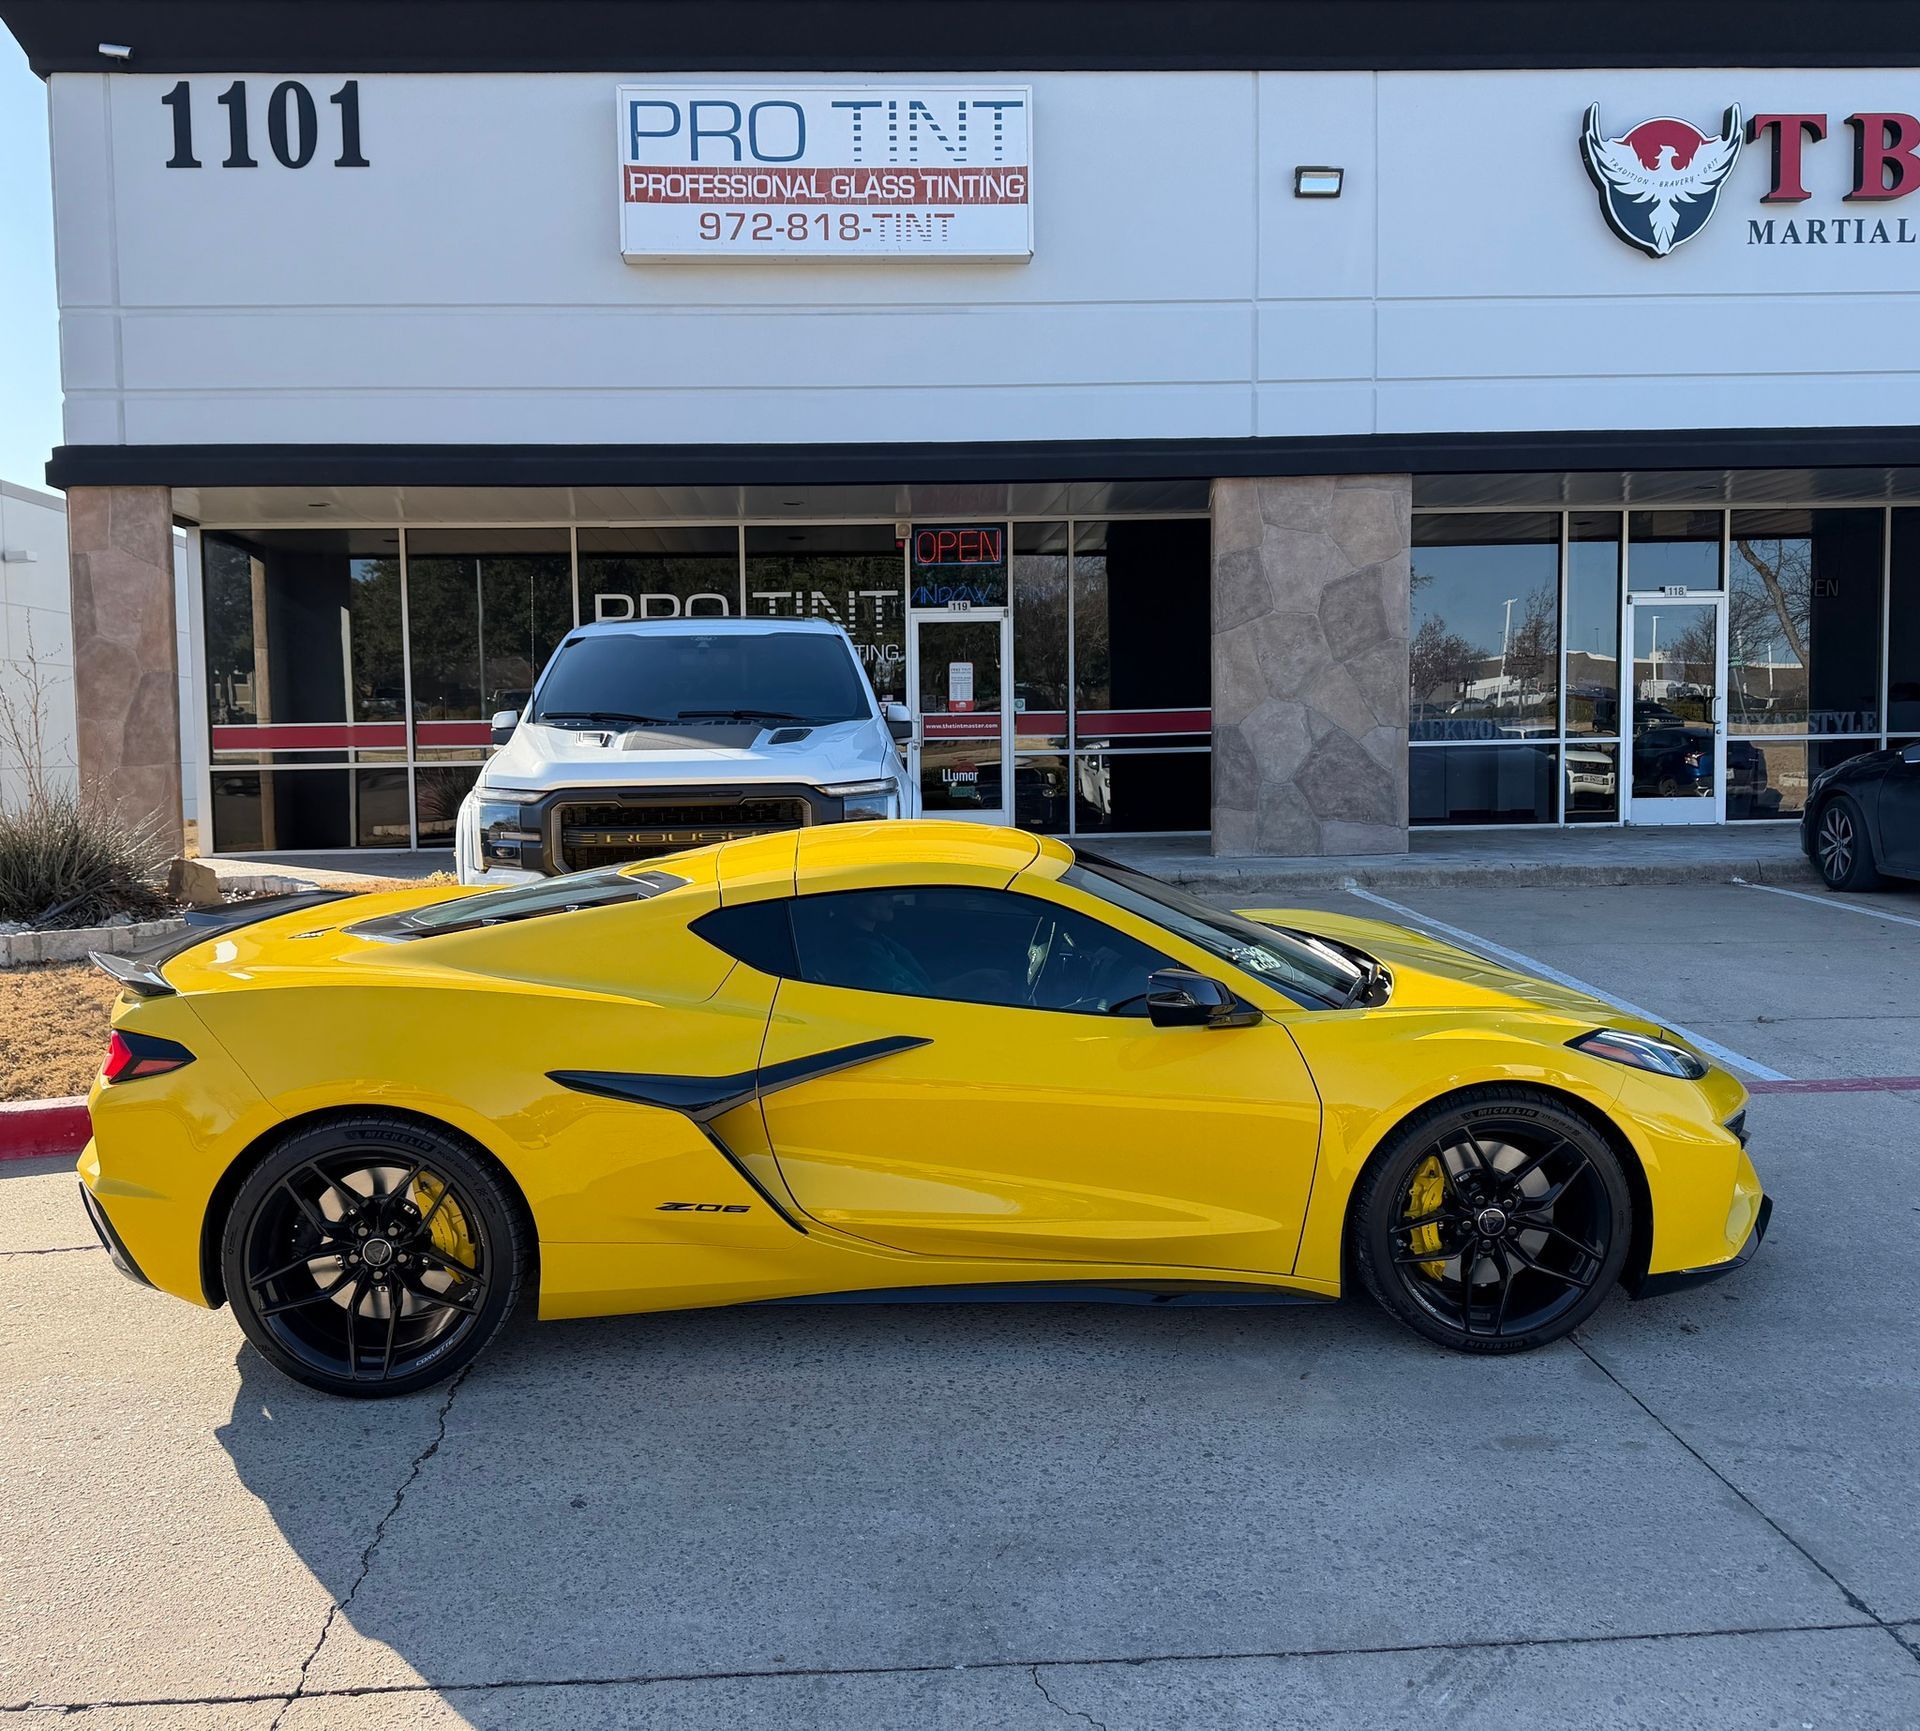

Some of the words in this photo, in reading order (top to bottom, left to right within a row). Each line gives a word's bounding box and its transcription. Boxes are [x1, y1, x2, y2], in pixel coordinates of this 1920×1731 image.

[161, 80, 370, 168] 1101
[629, 100, 808, 162] PRO
[831, 100, 1024, 162] TINT
[1609, 158, 1649, 185] TRADITION
[1659, 176, 1694, 187] BRAVERY
[630, 173, 828, 198] PROFESSIONAL
[831, 174, 916, 199] GLASS
[925, 174, 1025, 198] TINTING
[699, 212, 956, 242] 972-818-TINT
[1747, 218, 1917, 245] MARTIAL
[917, 531, 999, 563] OPEN
[1669, 587, 1684, 596] 118
[752, 590, 899, 635] TINT
[952, 602, 968, 611] 119
[1808, 711, 1877, 733] STYLE
[942, 768, 979, 782] LLumar
[1478, 1107, 1536, 1117] MICHELIN
[365, 1131, 431, 1150] MICHELIN
[654, 1202, 752, 1213] Z06
